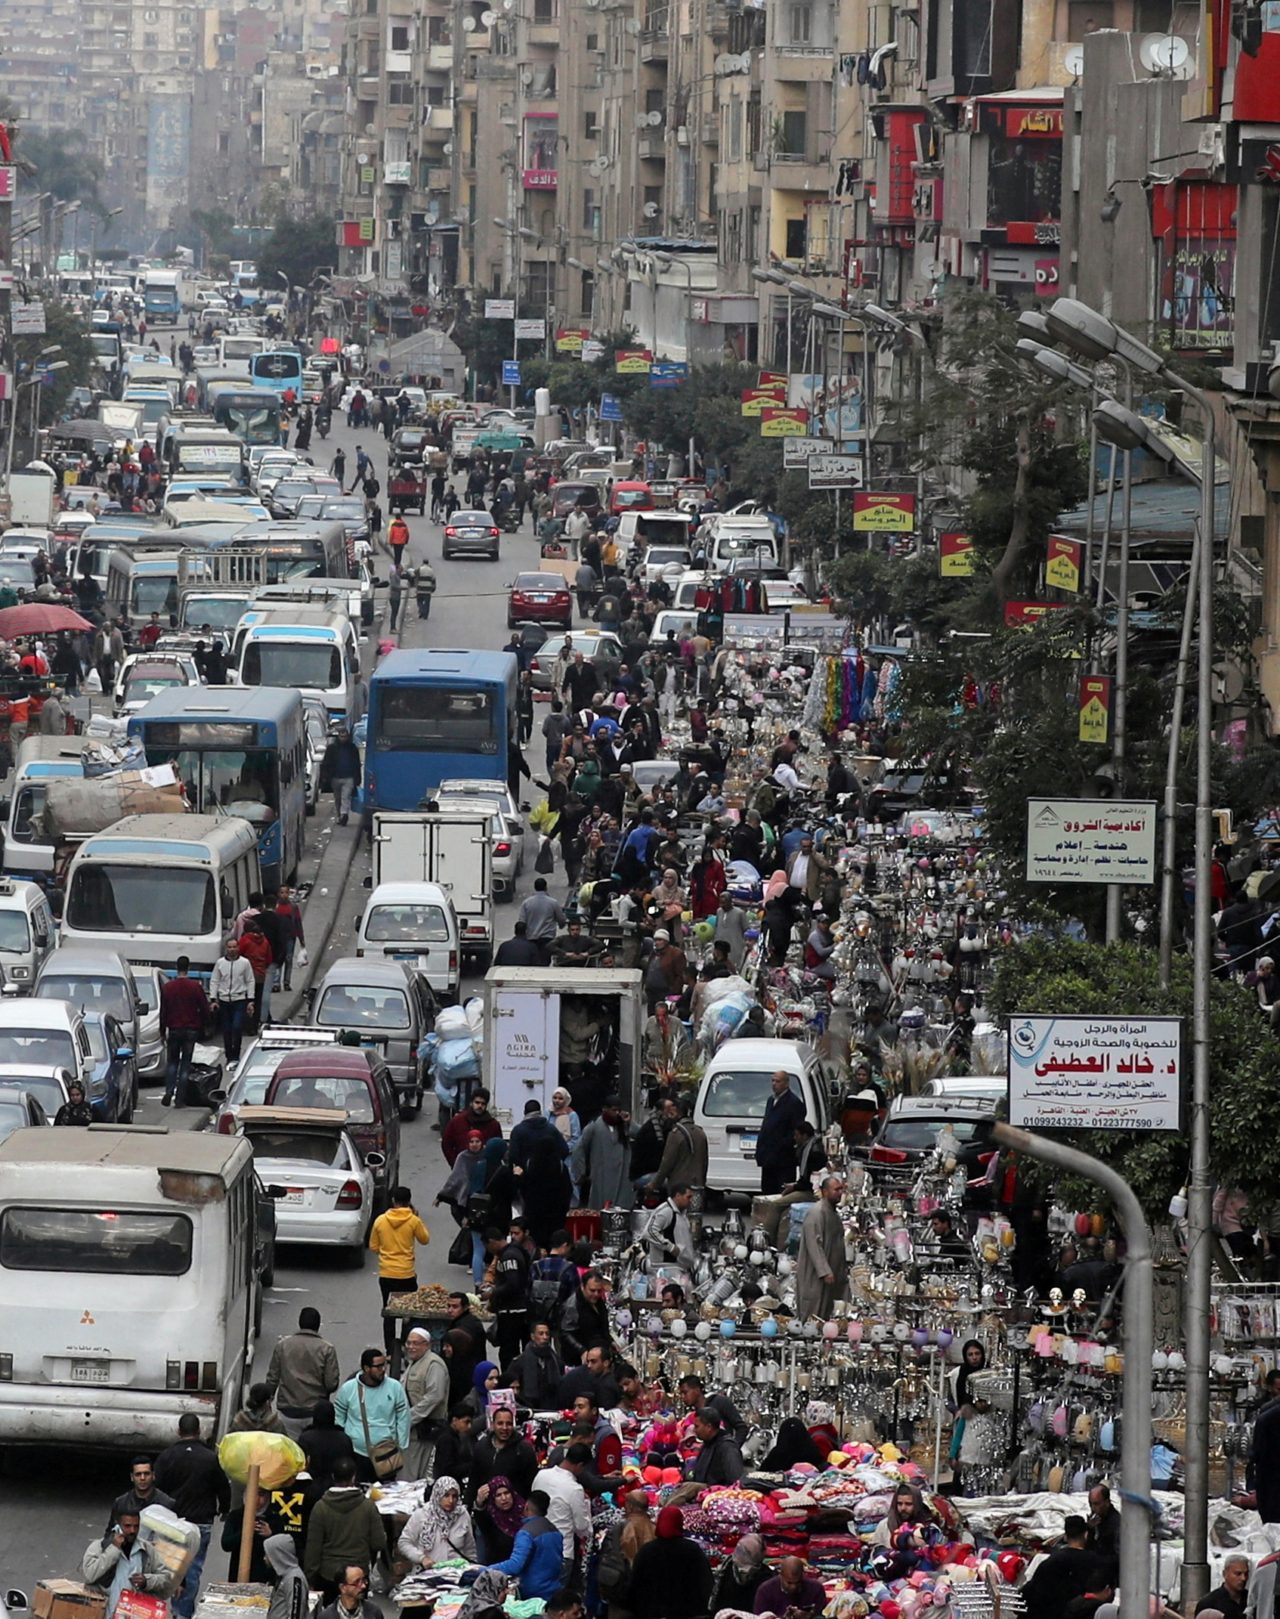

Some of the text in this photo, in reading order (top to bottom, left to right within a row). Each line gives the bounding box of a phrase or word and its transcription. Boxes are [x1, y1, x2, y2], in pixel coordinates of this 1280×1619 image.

[1063, 819, 1102, 833] الشروق
[1103, 818, 1146, 834] أكاديمية
[1056, 840, 1082, 852] إعلام
[1093, 840, 1128, 850] هندسة
[1084, 1024, 1147, 1035] المرأة والرجل
[1053, 1038, 1178, 1049] للخصوبة والصحة الزوجية
[1116, 1050, 1154, 1074] خالد
[1023, 1116, 1084, 1127] 01099243232
[1092, 1117, 1152, 1127] 01223777590
